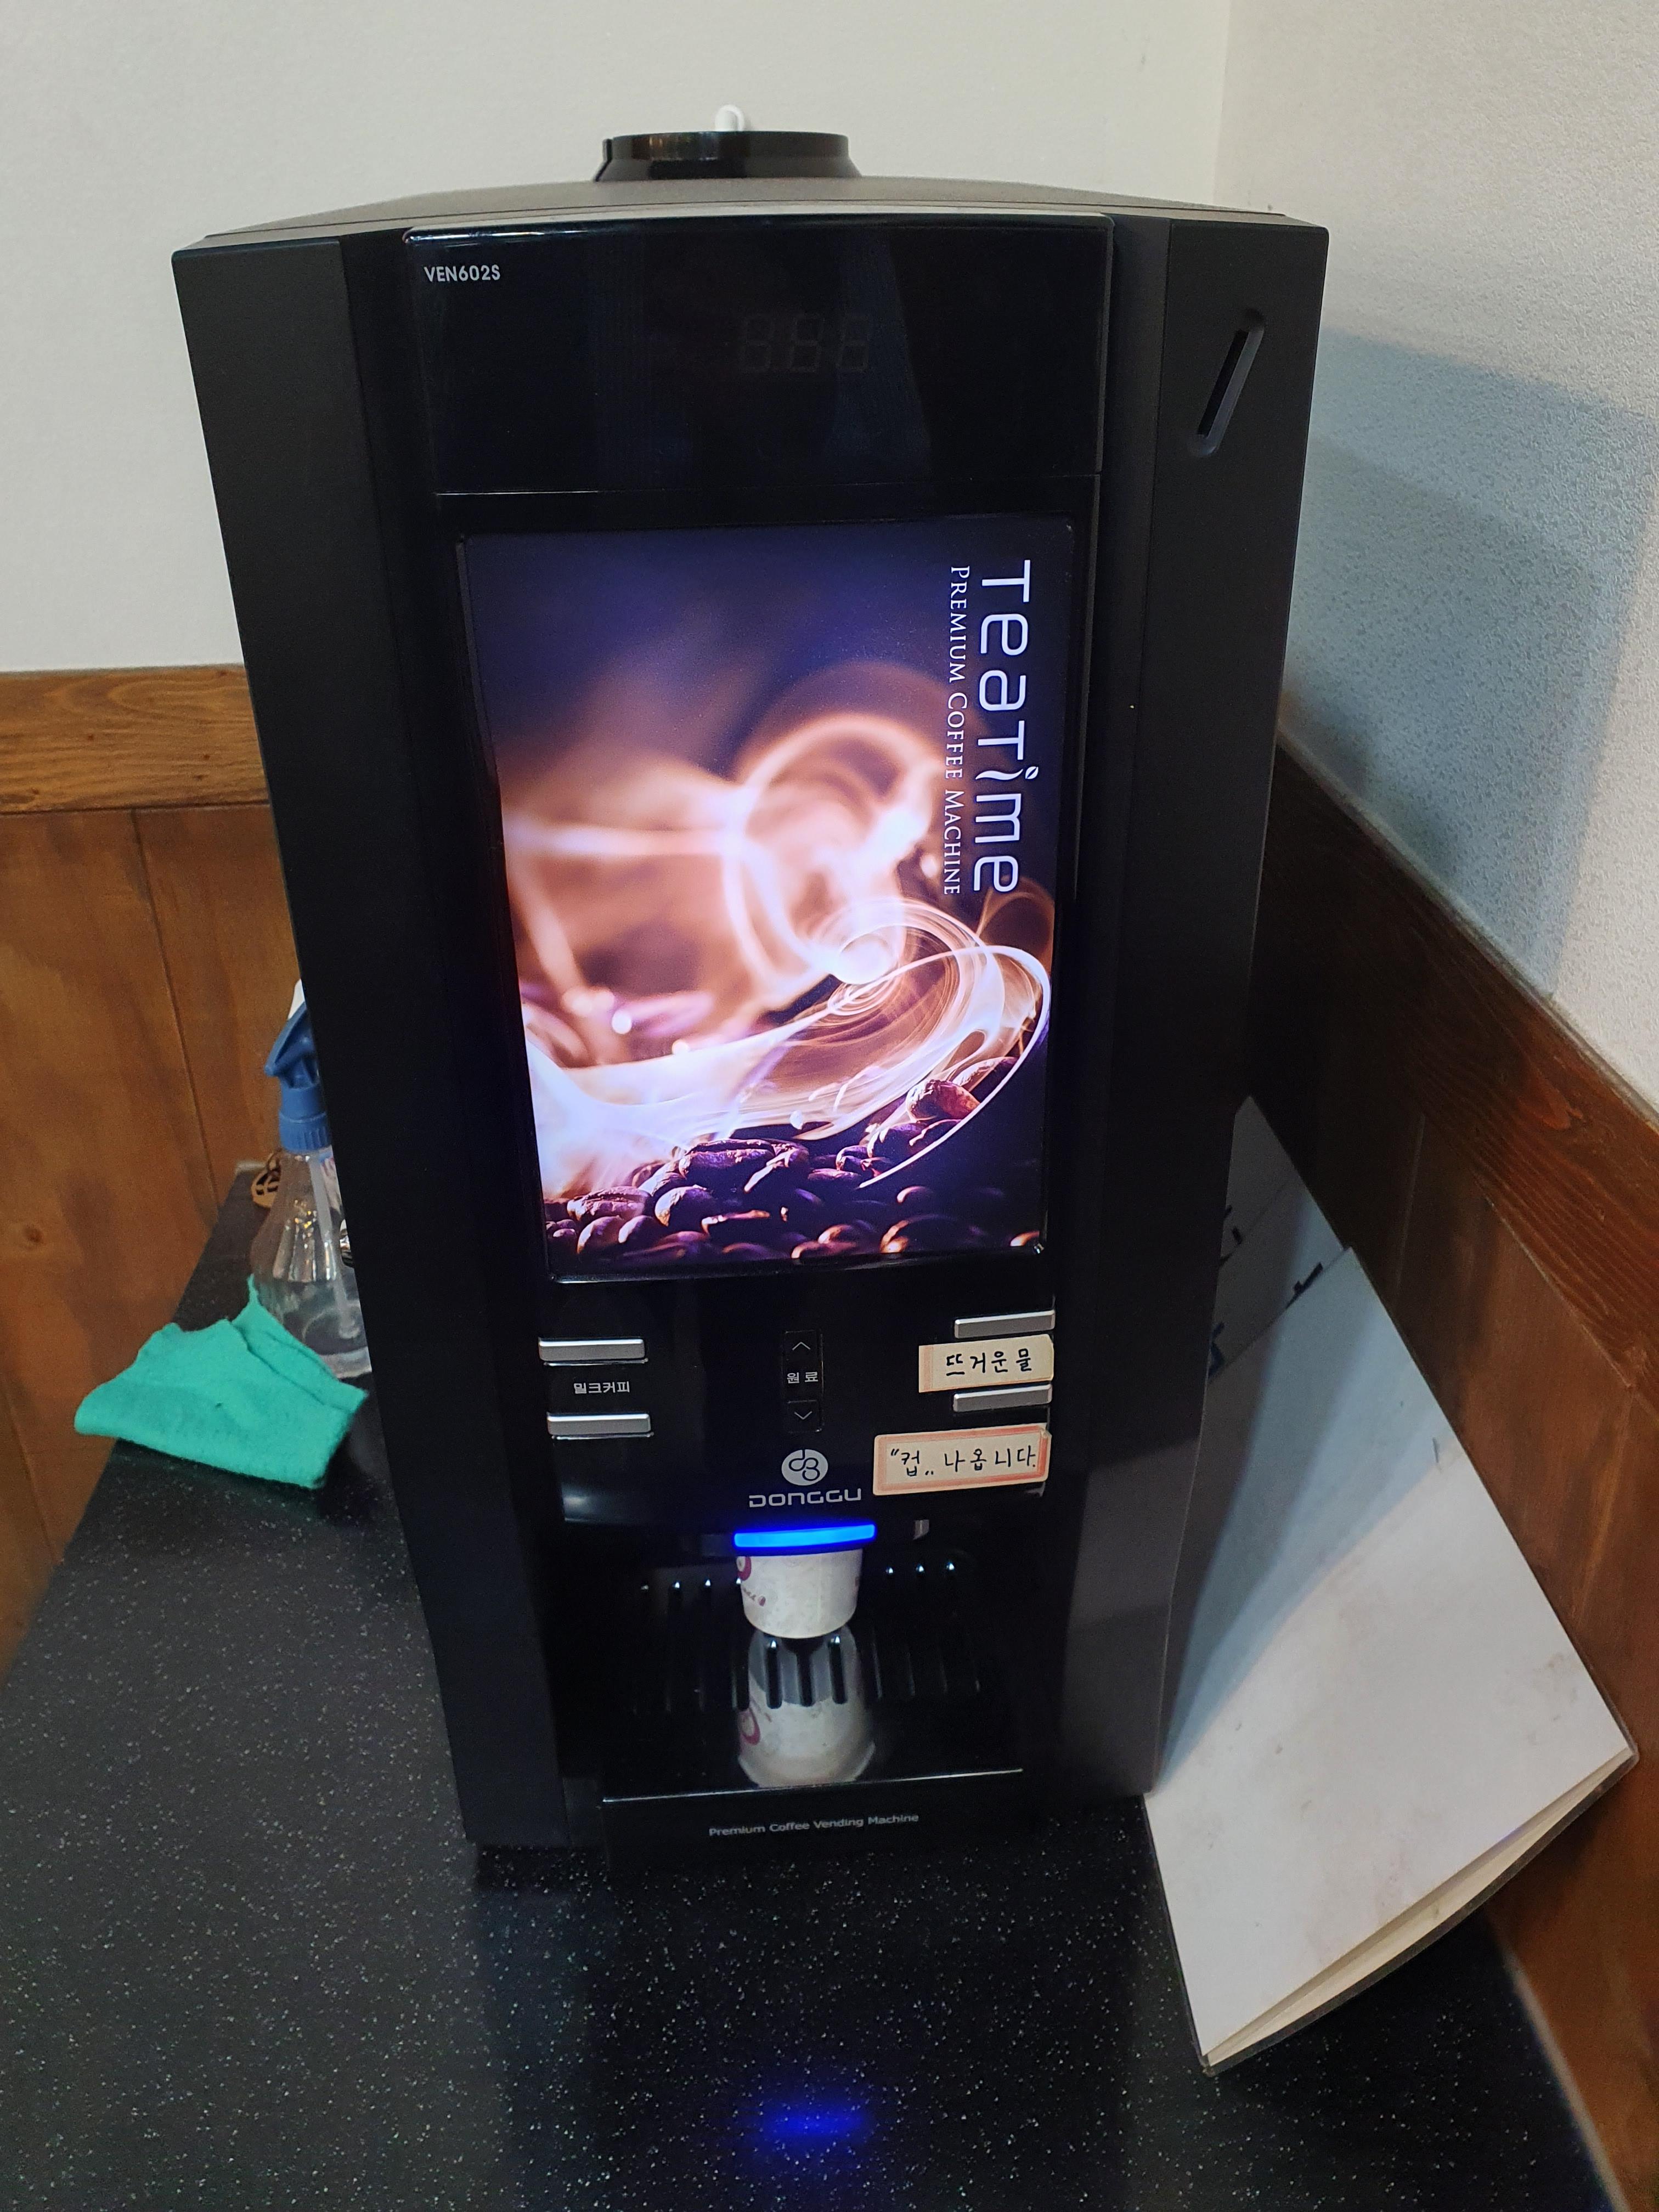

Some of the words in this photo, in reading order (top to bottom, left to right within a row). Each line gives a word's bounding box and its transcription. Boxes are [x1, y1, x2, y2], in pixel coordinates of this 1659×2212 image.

[424, 264, 500, 282] VEN602S
[947, 566, 970, 684] PREMIUM
[945, 692, 968, 780] COFFEE
[944, 789, 964, 895] MACHINE
[573, 1380, 631, 1395] 밀크커피
[749, 1488, 861, 1508] DONGGU
[708, 1824, 766, 1837] Premium
[769, 1821, 810, 1833] Coffee
[812, 1818, 865, 1829] Vending
[868, 1814, 919, 1825] Machine
